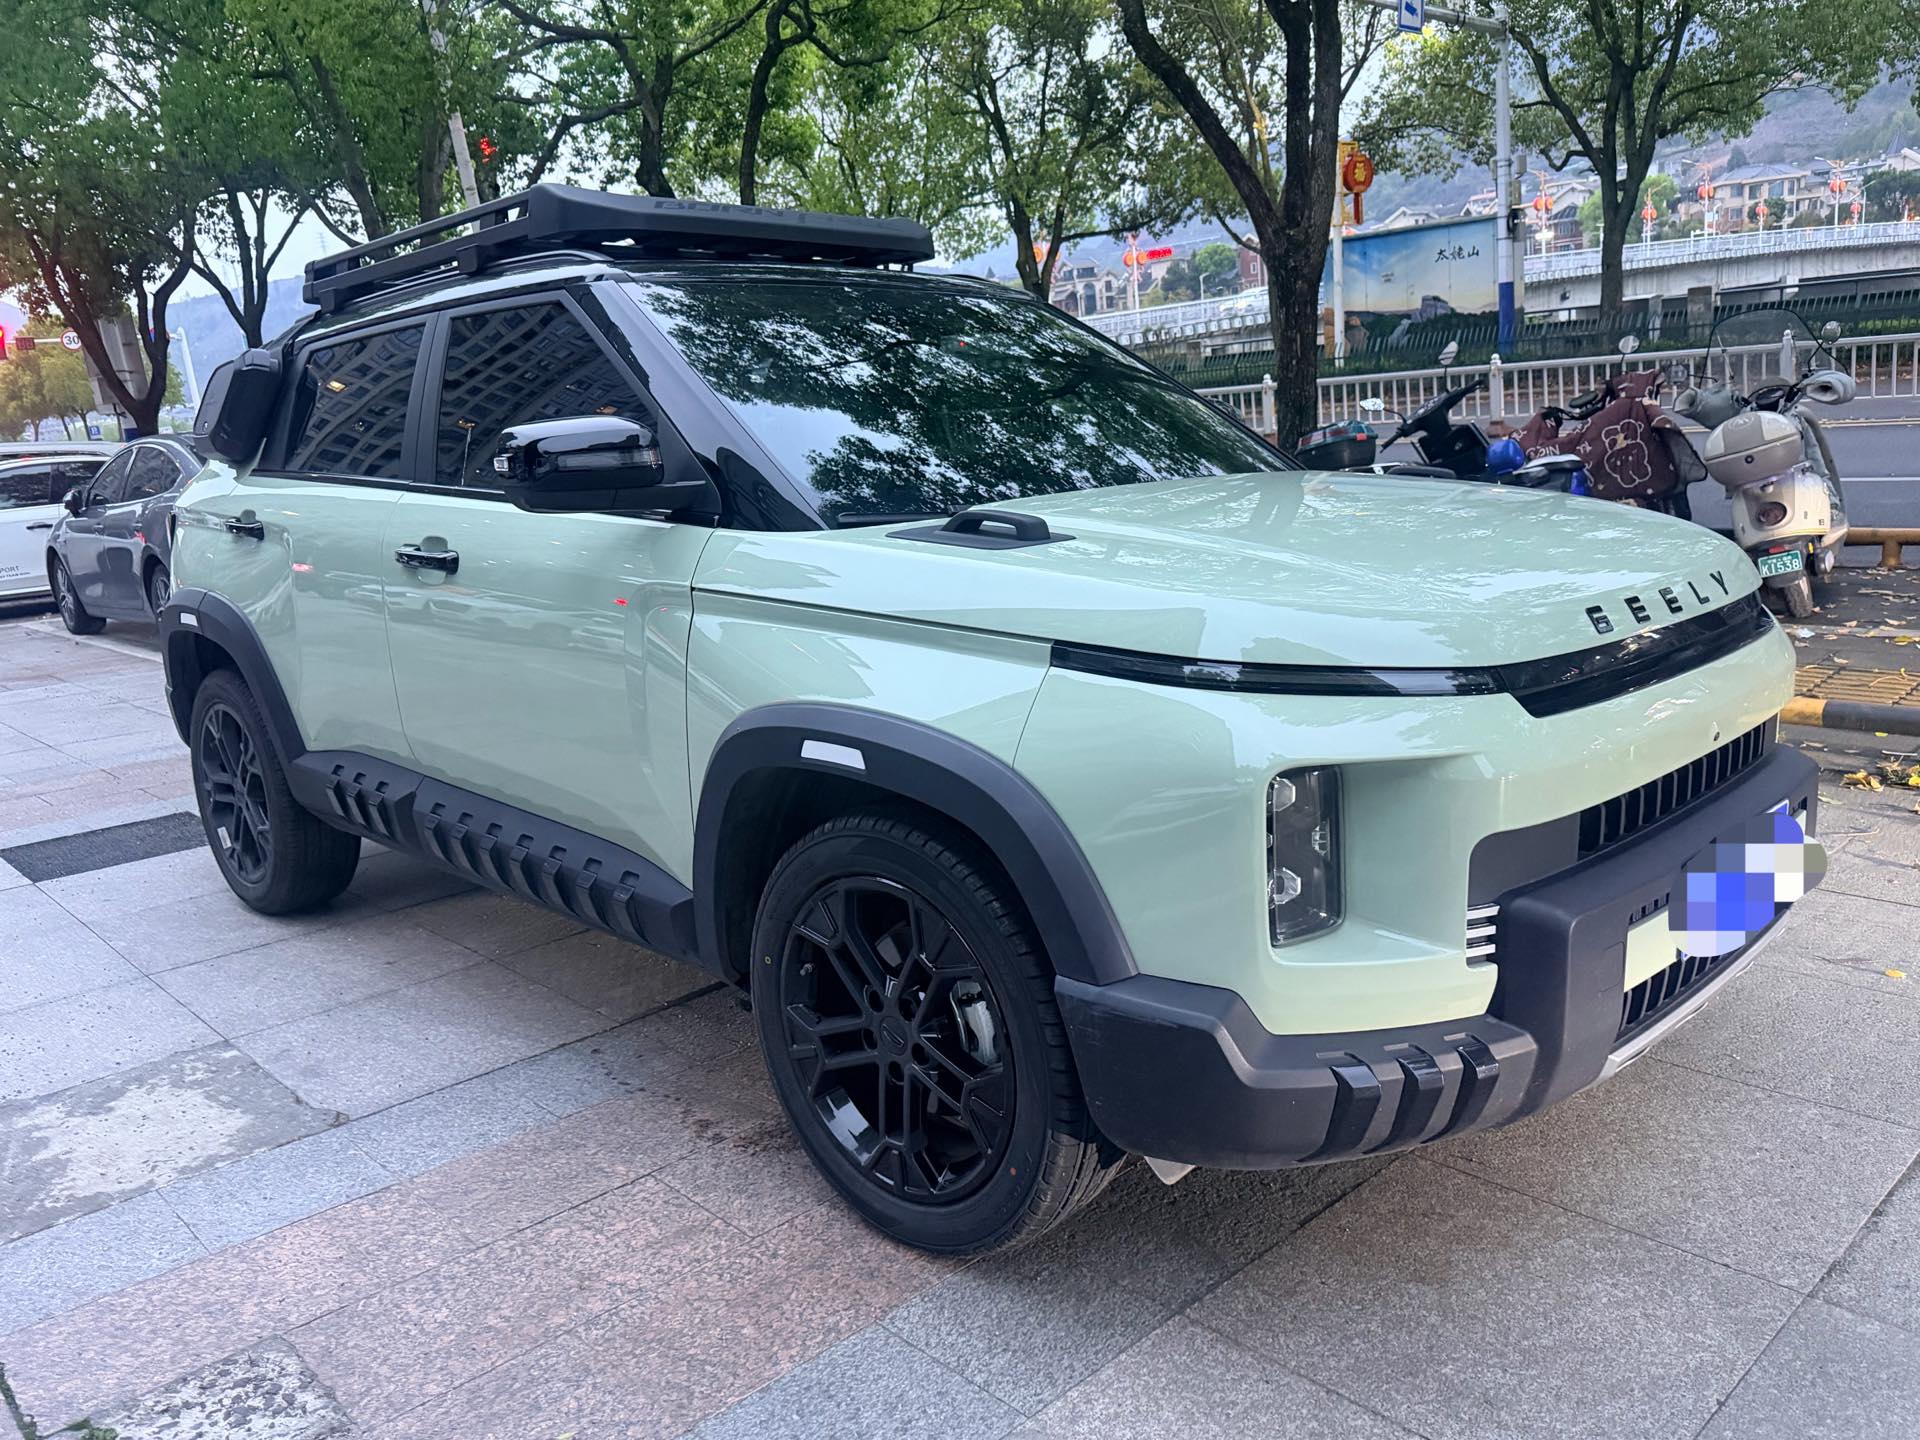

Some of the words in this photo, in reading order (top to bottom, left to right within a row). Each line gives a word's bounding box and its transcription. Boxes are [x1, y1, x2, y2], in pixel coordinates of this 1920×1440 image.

[1434, 245, 1480, 263] 太姥山
[64, 335, 80, 345] 30
[1761, 558, 1800, 576] K1538
[1585, 570, 1729, 634] GEELY
